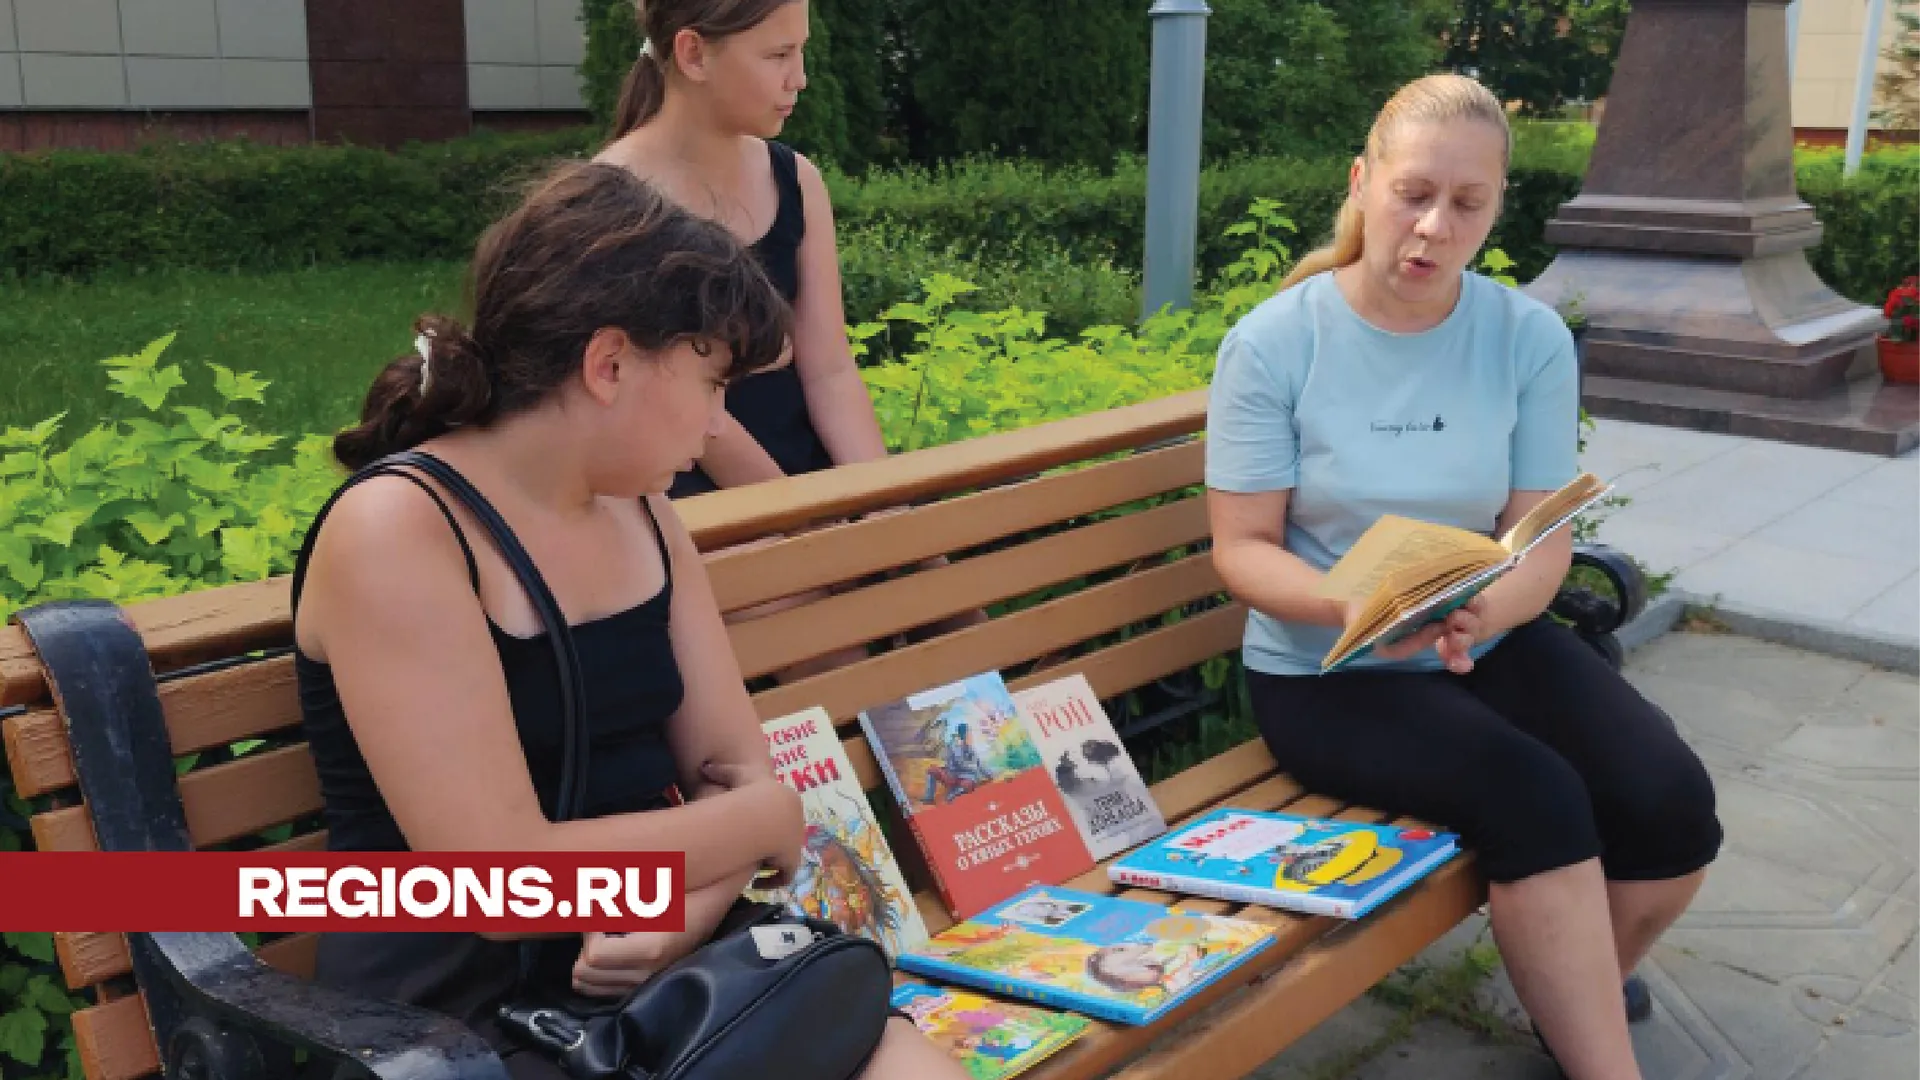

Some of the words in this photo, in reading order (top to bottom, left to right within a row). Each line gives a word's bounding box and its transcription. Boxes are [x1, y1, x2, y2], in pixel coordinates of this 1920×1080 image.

[1033, 696, 1095, 739] РОЙ
[953, 799, 1049, 852] РАССКАЗЫ
[957, 856, 969, 871] О
[969, 837, 1015, 865] ЮНЫХ
[1014, 818, 1064, 846] ГЕРОЯХ
